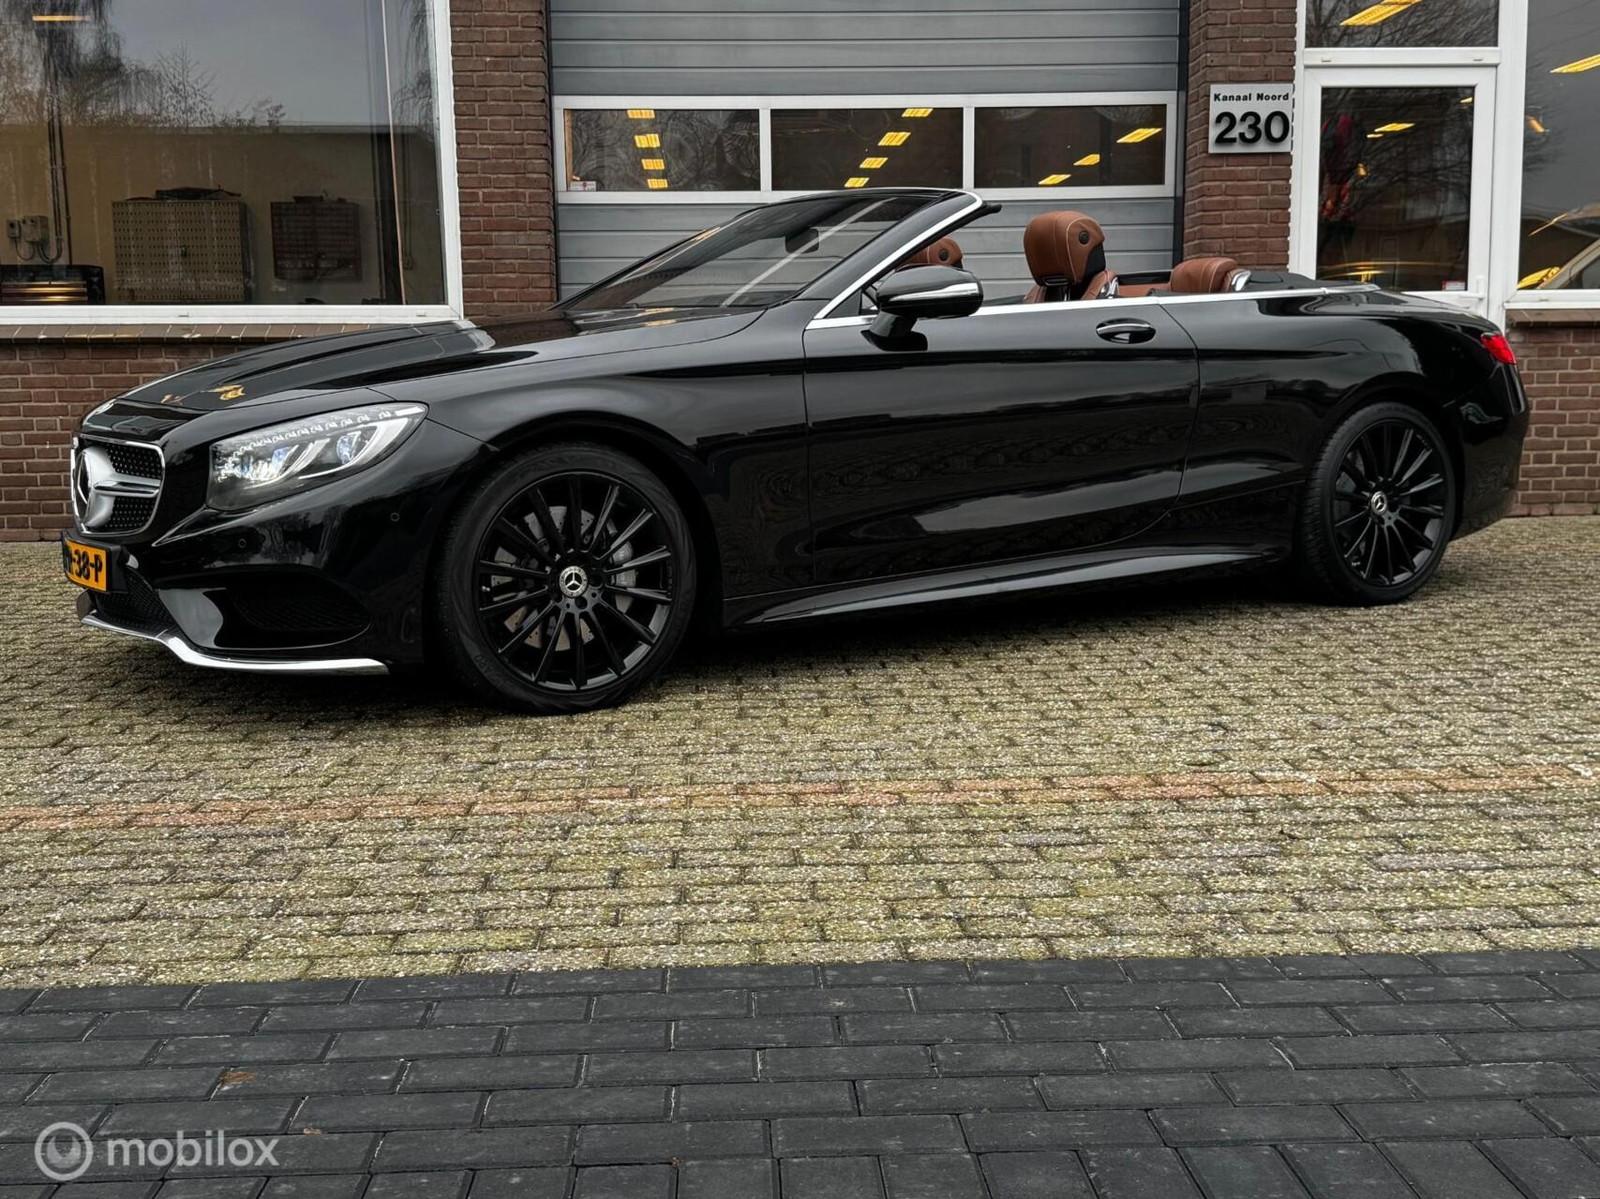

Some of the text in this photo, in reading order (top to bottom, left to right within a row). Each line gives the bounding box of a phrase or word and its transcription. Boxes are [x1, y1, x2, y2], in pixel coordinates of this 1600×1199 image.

[1213, 92, 1290, 102] Kanaal Noord
[1214, 110, 1290, 144] 230
